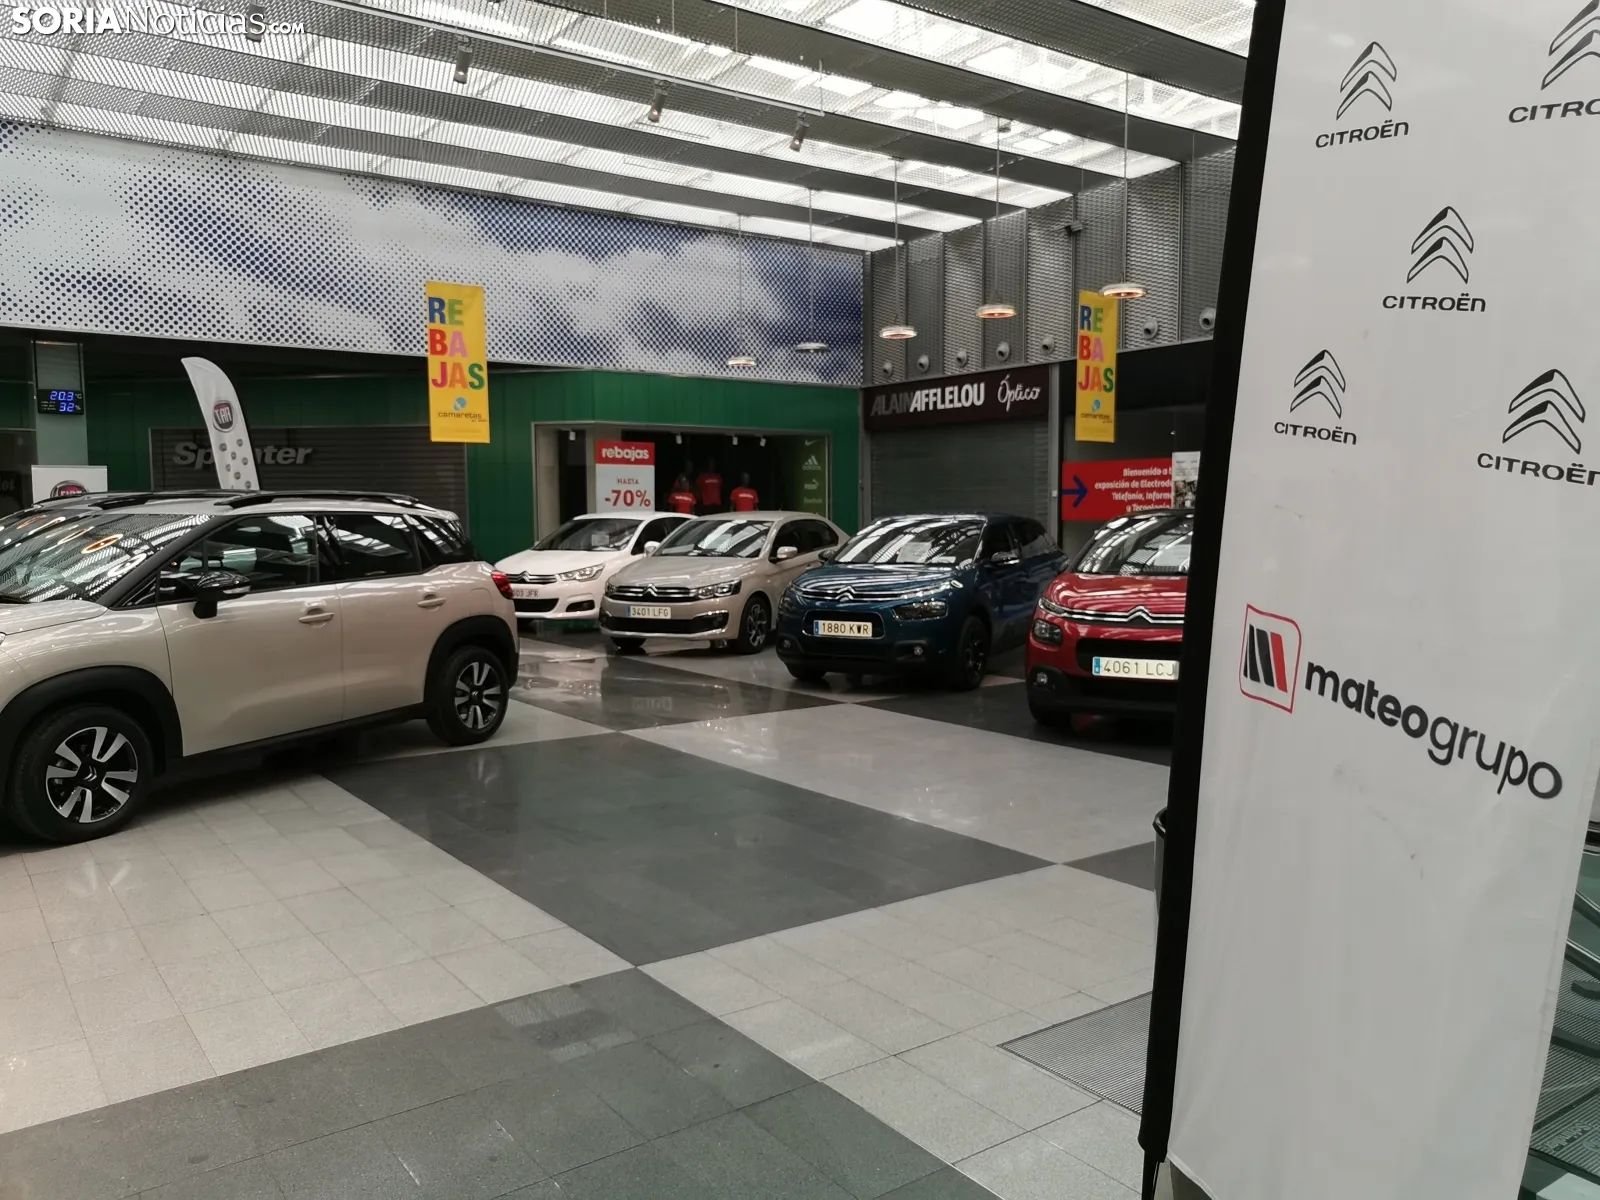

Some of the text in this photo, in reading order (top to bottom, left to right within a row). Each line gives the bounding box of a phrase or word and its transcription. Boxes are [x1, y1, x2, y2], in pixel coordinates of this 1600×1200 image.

[997, 374, 1042, 413] Óptico
[59, 402, 74, 412] 32
[172, 441, 313, 470] Spter
[601, 445, 650, 462] rebajas
[1123, 466, 1161, 476] Bienvenido
[1094, 480, 1130, 491] exposición
[1130, 480, 1140, 488] de
[604, 489, 652, 508] -70%
[631, 607, 669, 617] 3401 LFG
[822, 622, 846, 634] 1880
[1103, 660, 1176, 677] 4061 LCJ
[1304, 661, 1563, 800] mateogrupo
